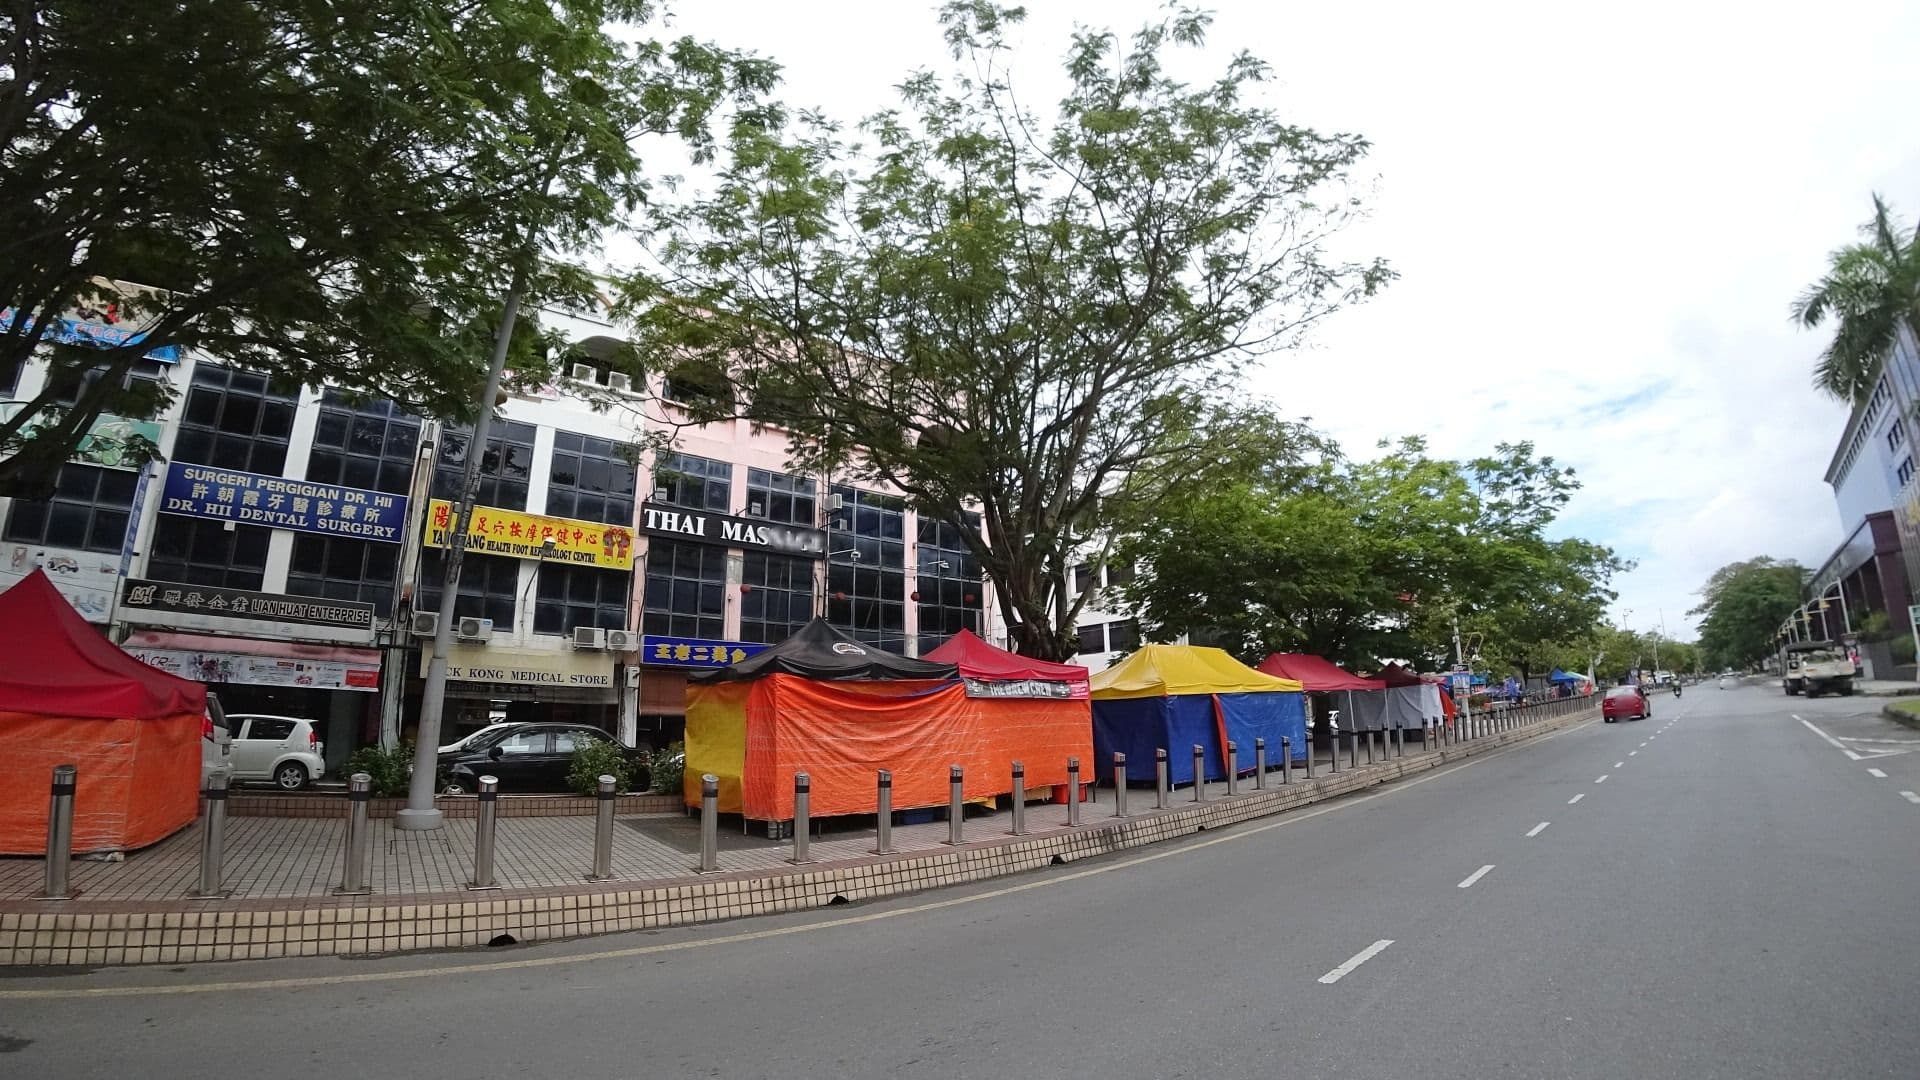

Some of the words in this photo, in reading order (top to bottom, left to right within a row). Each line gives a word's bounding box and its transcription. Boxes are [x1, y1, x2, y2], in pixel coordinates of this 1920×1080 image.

[183, 467, 252, 488] SURGERI
[257, 478, 339, 500] PERGIGIAN
[344, 490, 368, 505] DR.
[374, 494, 393, 508] HII
[191, 483, 381, 523] 許朝霞牙醫診療所
[167, 497, 198, 513] DR.
[204, 503, 232, 518] HII
[239, 507, 309, 528] DENTAL
[317, 518, 396, 539] SURGERY
[433, 504, 598, 547] 陽足穴按摩保健中心
[643, 508, 706, 537] THAI
[486, 541, 511, 554] HEALTH
[512, 543, 529, 556] FOOT
[530, 546, 572, 561] REFOLOGY
[573, 551, 596, 564] CENTRE
[251, 599, 278, 615] LIAN
[278, 601, 308, 618] HUAT
[307, 605, 372, 623] ENTERPRISE
[469, 668, 505, 680] KONG
[510, 670, 564, 683] MEDICAL
[570, 674, 608, 685] STORE
